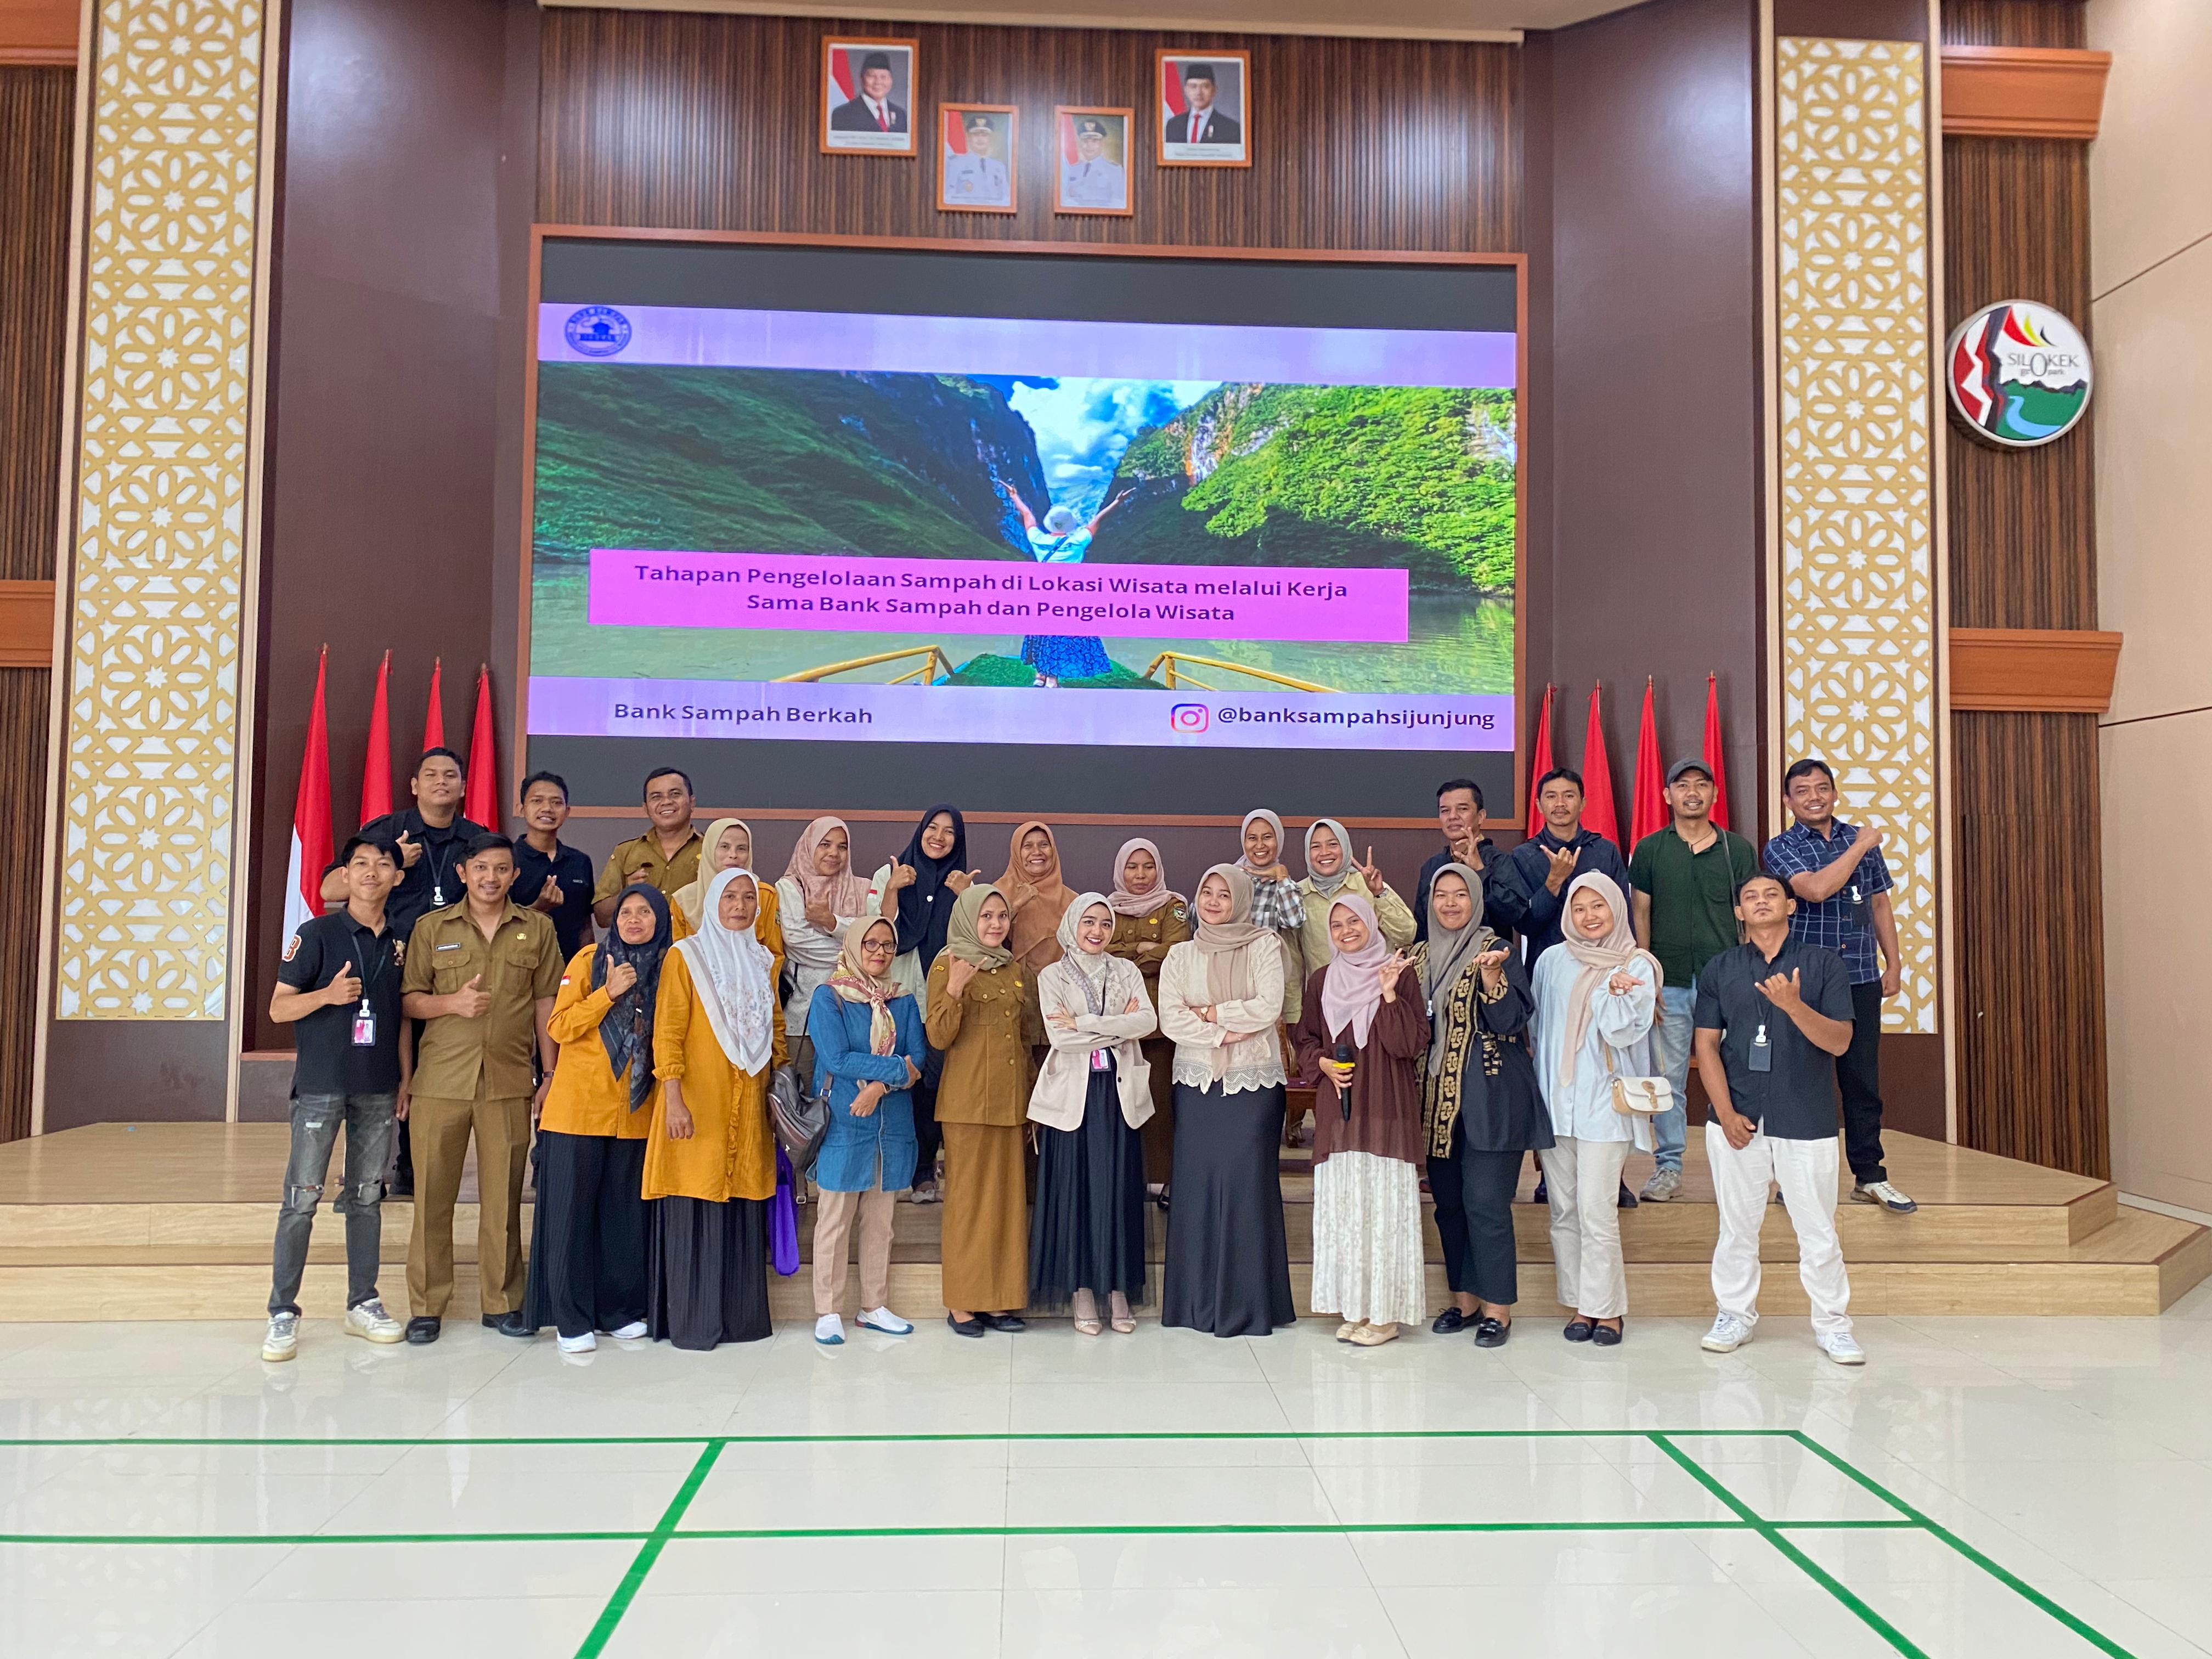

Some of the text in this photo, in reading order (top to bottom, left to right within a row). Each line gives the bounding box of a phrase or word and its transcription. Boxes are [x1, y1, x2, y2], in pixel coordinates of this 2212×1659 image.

[2007, 352, 2079, 376] SILOKEK
[635, 566, 1346, 601] Tahapan Pengelolaan Sampah di Lokasi Wisata melalui Kerja
[747, 595, 1234, 622] Sama Bank Sampah dan Pengelola Wisata
[614, 704, 872, 725] Bank Sampah Berkah
[1218, 707, 1495, 730] @banksampahsijunjung
